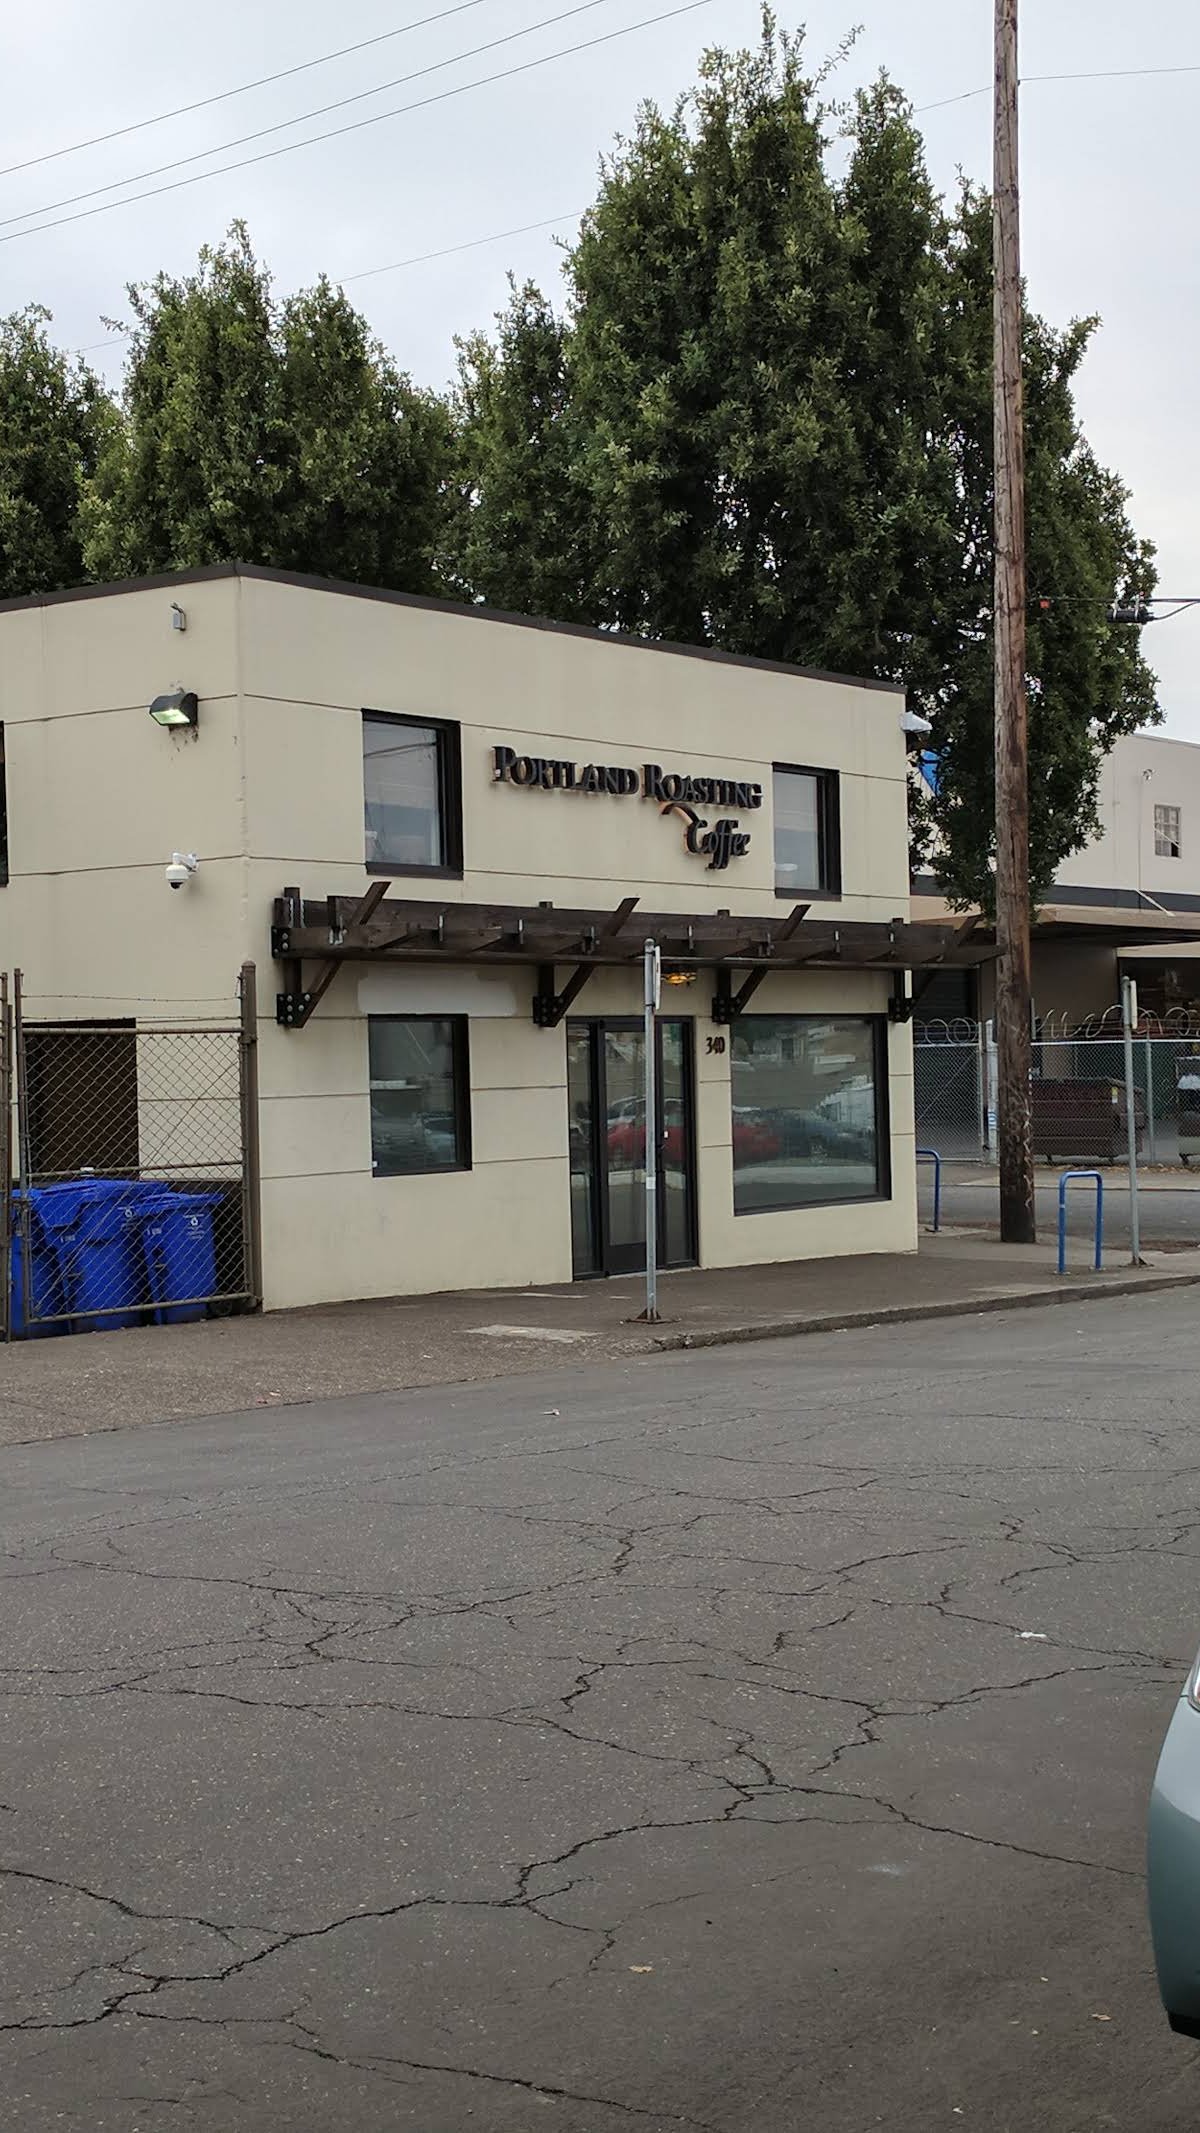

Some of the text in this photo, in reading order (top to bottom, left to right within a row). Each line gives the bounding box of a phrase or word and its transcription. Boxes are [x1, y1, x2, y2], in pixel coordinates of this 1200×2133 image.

[492, 746, 762, 809] PORTLAND ROASTING
[684, 818, 751, 871] Coffee
[705, 1036, 726, 1055] 340
